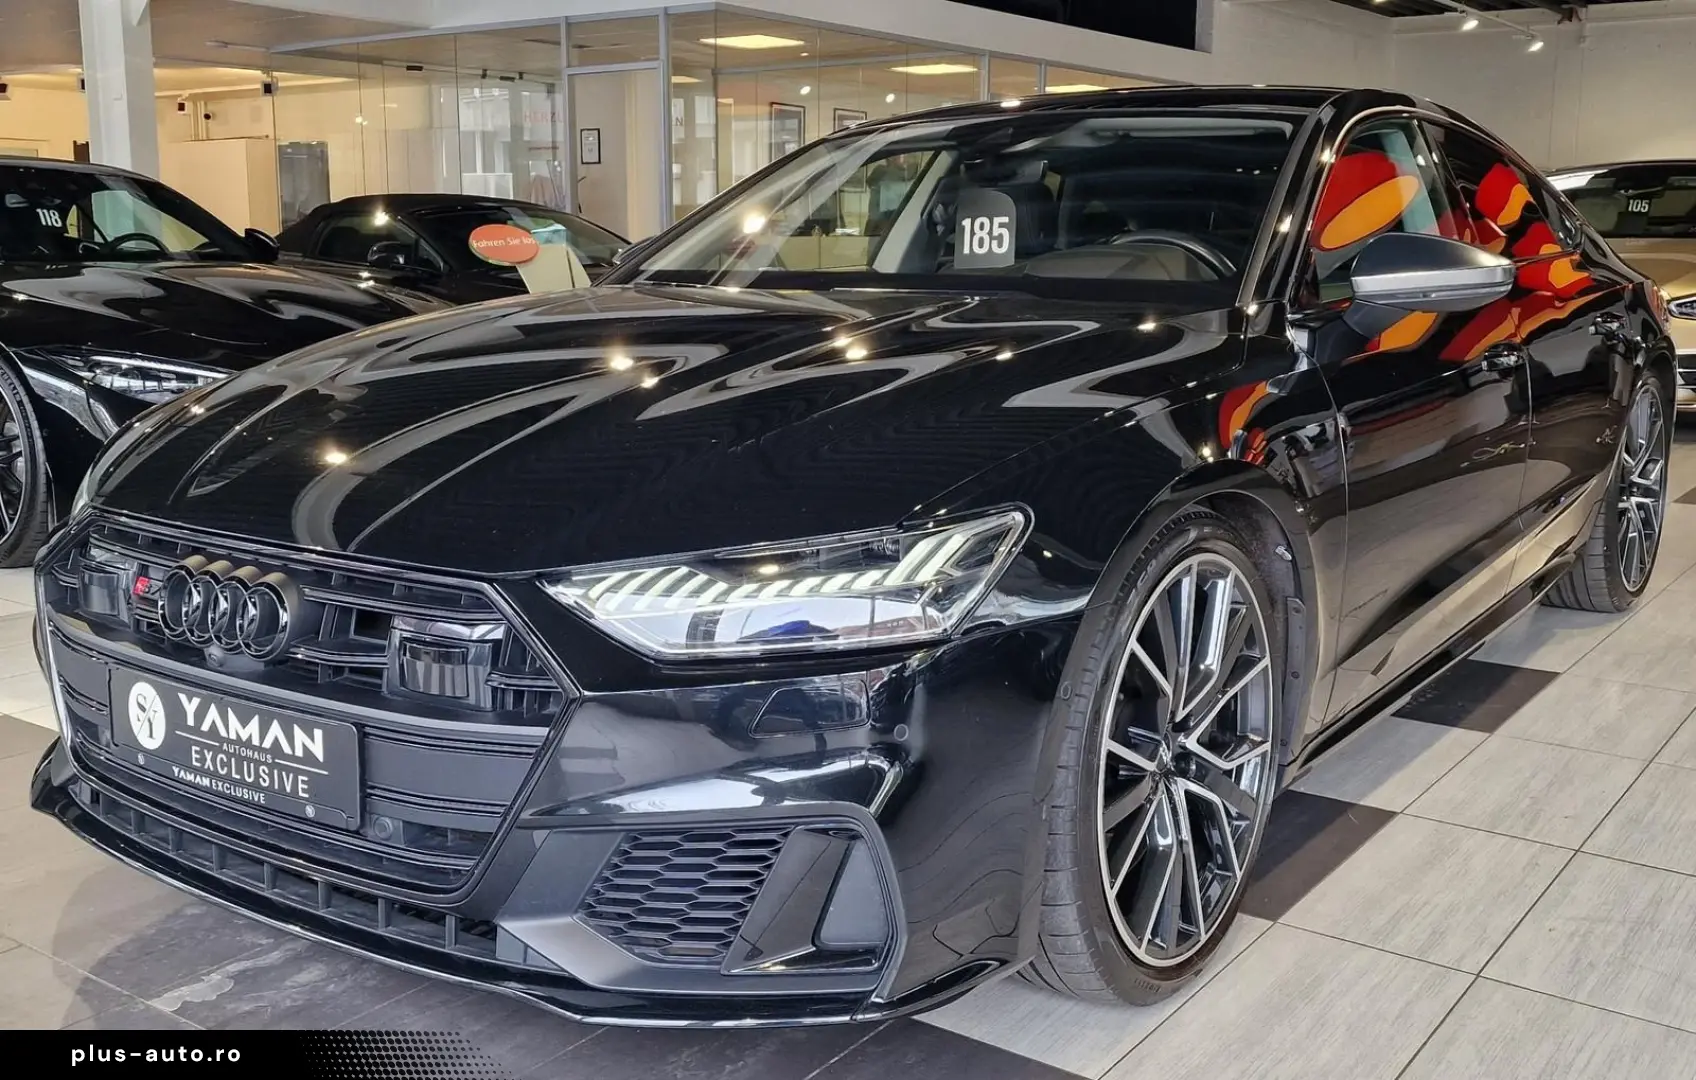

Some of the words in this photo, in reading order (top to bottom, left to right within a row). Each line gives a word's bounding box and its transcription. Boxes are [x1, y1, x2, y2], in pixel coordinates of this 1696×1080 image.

[36, 208, 62, 228] 118
[1628, 199, 1650, 212] 105
[472, 239, 505, 248] Fahren
[506, 237, 520, 246] Sie
[961, 216, 1010, 255] 185
[177, 692, 324, 763] YAMAN
[222, 742, 273, 764] AUTOHAUS
[172, 766, 210, 788] YAMAN
[211, 779, 266, 804] EXCLUSIVE
[191, 745, 310, 798] EXCLUSIVE
